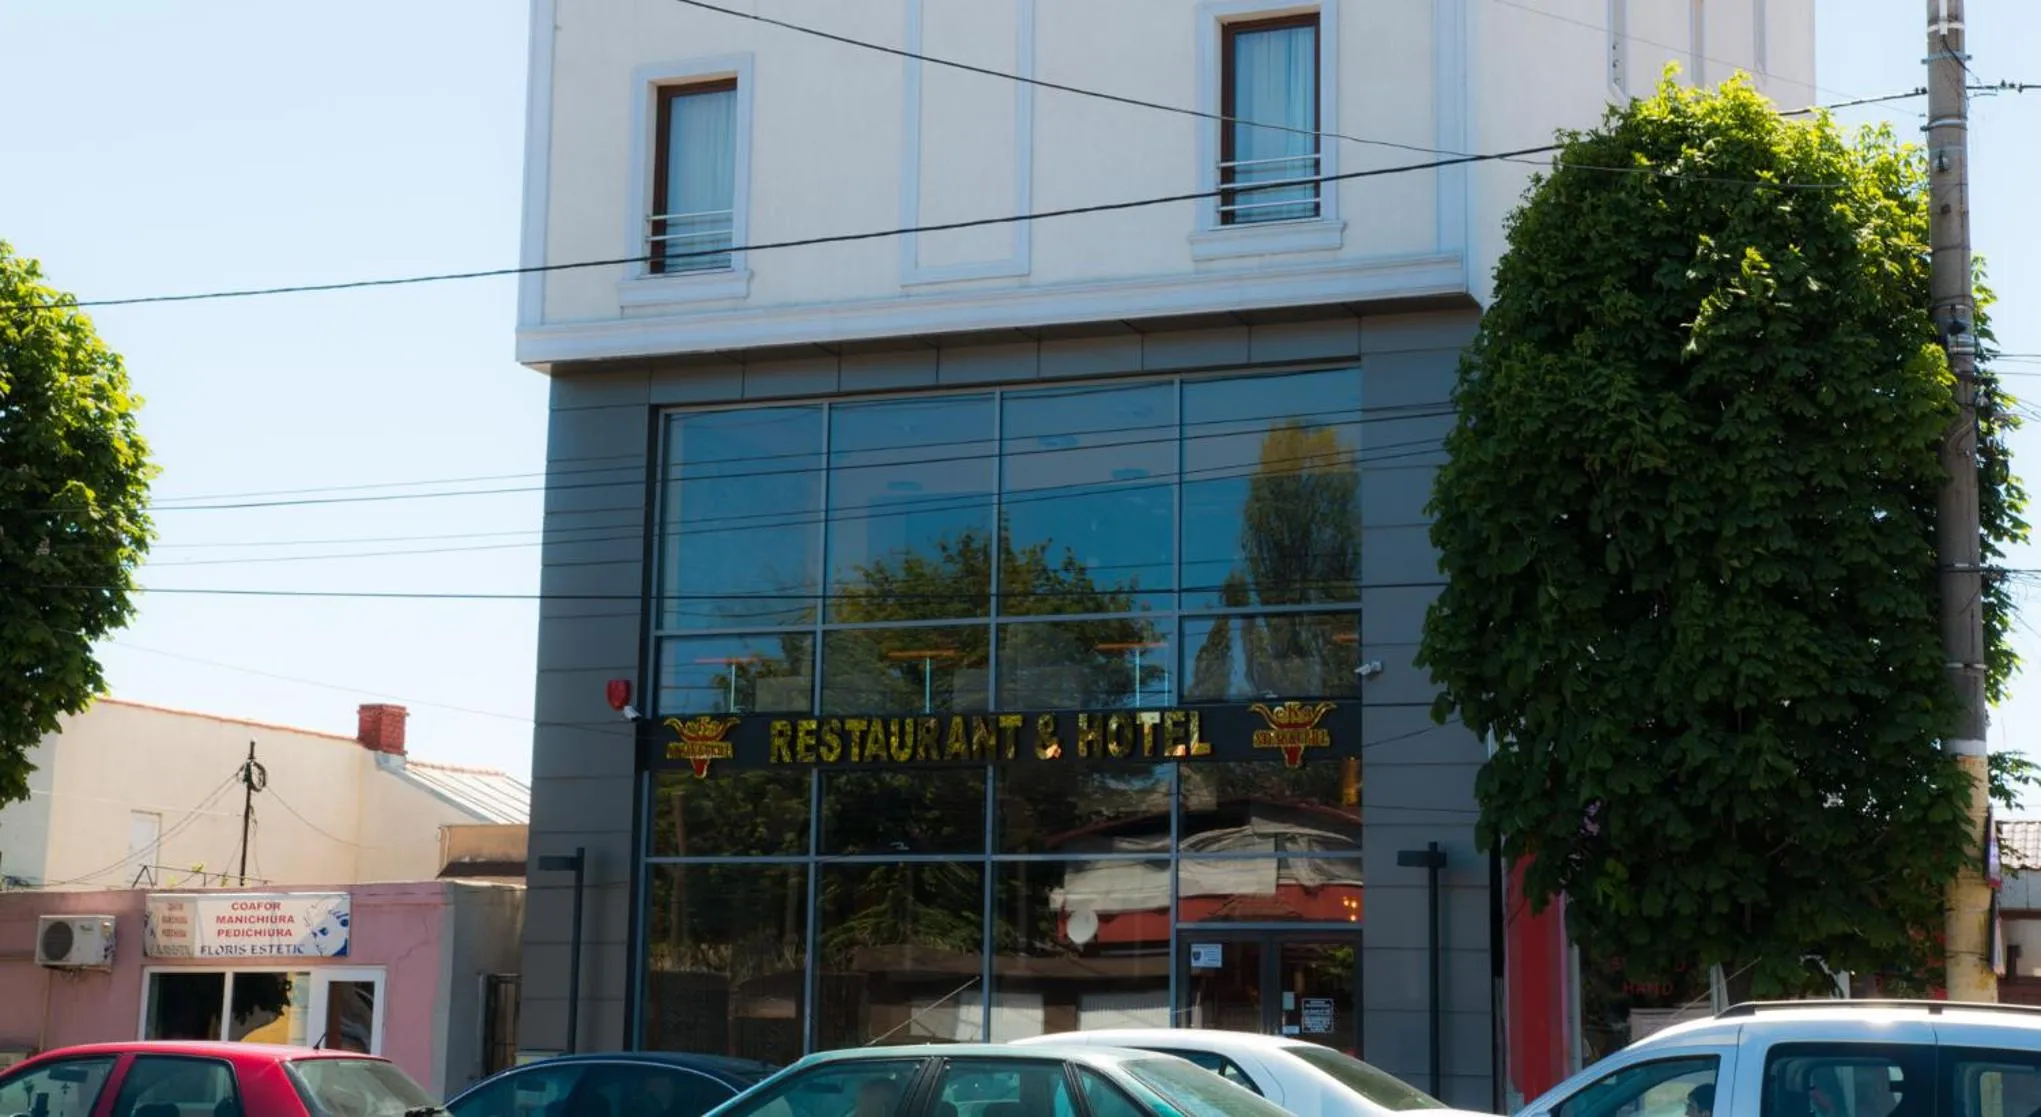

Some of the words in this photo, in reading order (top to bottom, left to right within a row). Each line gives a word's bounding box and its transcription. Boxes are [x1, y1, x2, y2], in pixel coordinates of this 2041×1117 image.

[769, 713, 1023, 764] RESTAURANT
[1036, 711, 1062, 761] &
[1078, 709, 1212, 758] HOTEL
[231, 901, 281, 912] COAFOR
[215, 914, 295, 924] MANICHIURA
[217, 928, 293, 938] PEDICHIURA
[200, 944, 247, 956] FLORIS
[251, 943, 306, 955] ESTETIC
